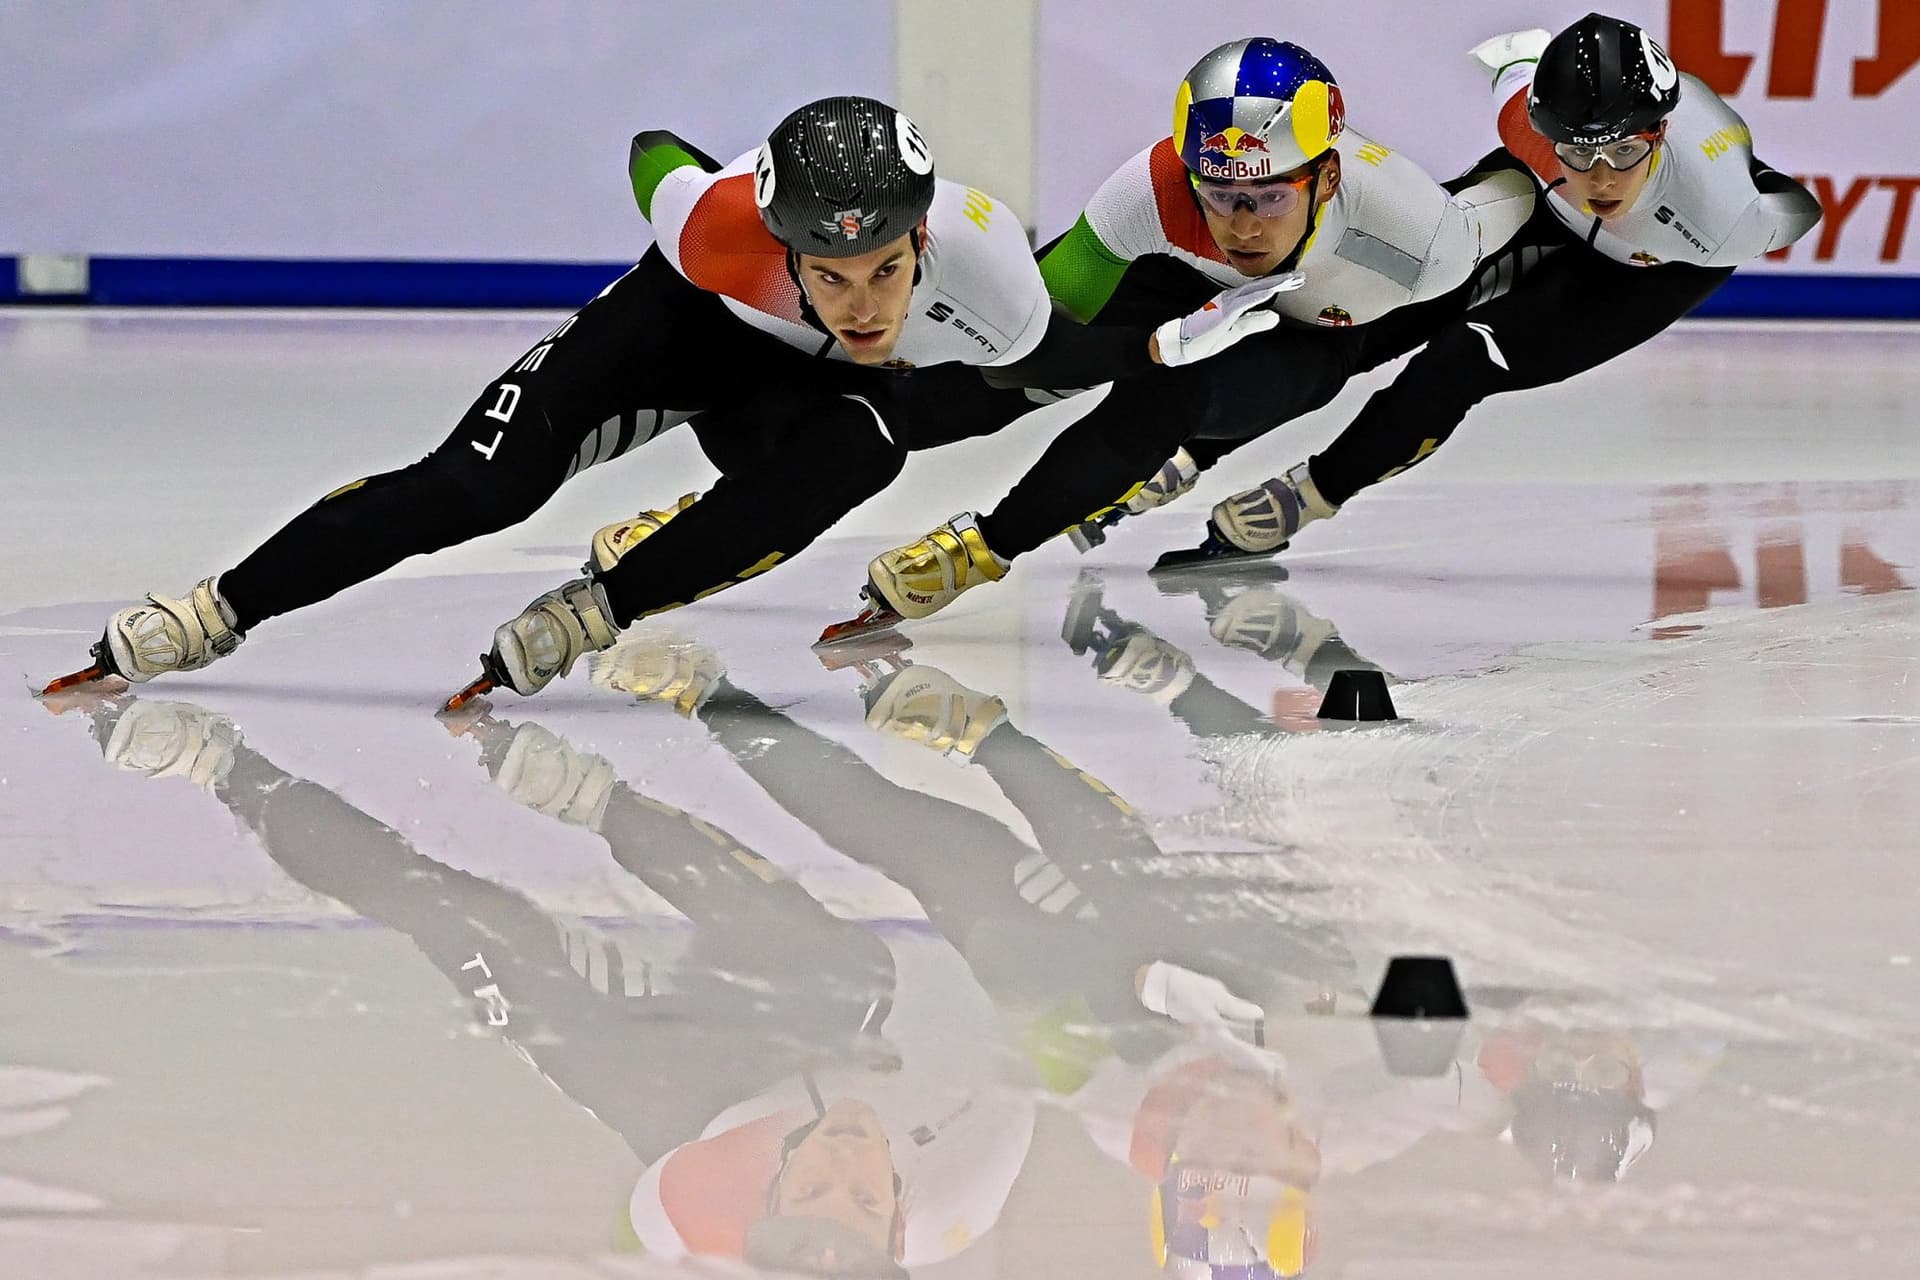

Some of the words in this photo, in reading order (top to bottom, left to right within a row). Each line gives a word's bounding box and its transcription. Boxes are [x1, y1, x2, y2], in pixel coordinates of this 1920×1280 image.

[1572, 130, 1622, 145] RUDY
[1764, 175, 1920, 263] YT
[1673, 221, 1710, 254] SEAT
[952, 318, 999, 353] SEAT
